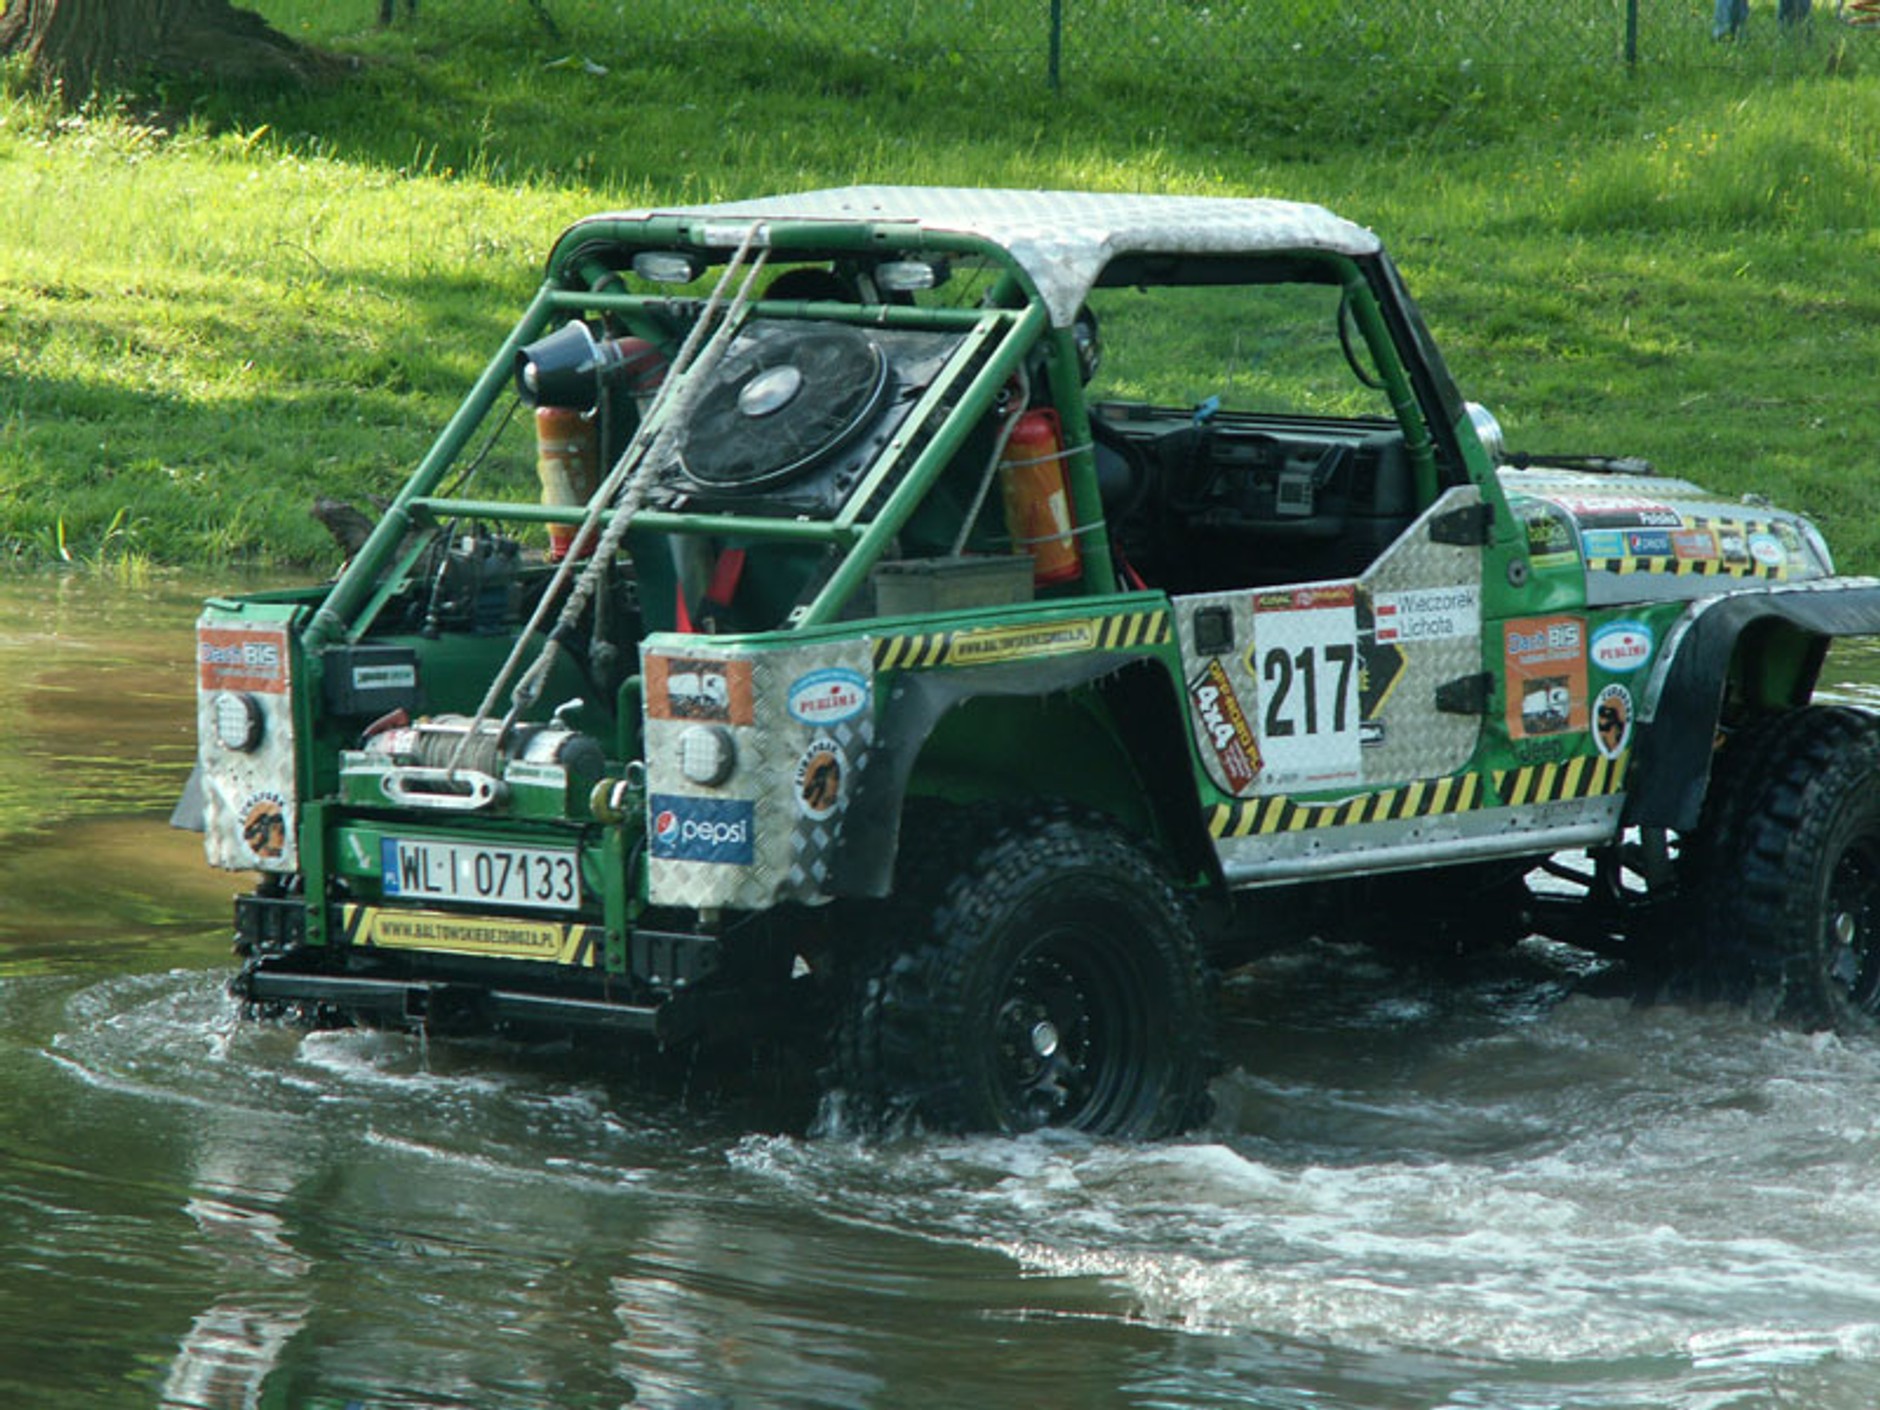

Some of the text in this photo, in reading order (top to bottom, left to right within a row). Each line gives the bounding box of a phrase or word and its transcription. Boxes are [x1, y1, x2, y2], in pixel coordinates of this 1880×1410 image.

[1401, 616, 1453, 637] Lichota
[1264, 644, 1354, 738] 217
[682, 819, 746, 850] pepsi
[475, 852, 574, 901] 07133
